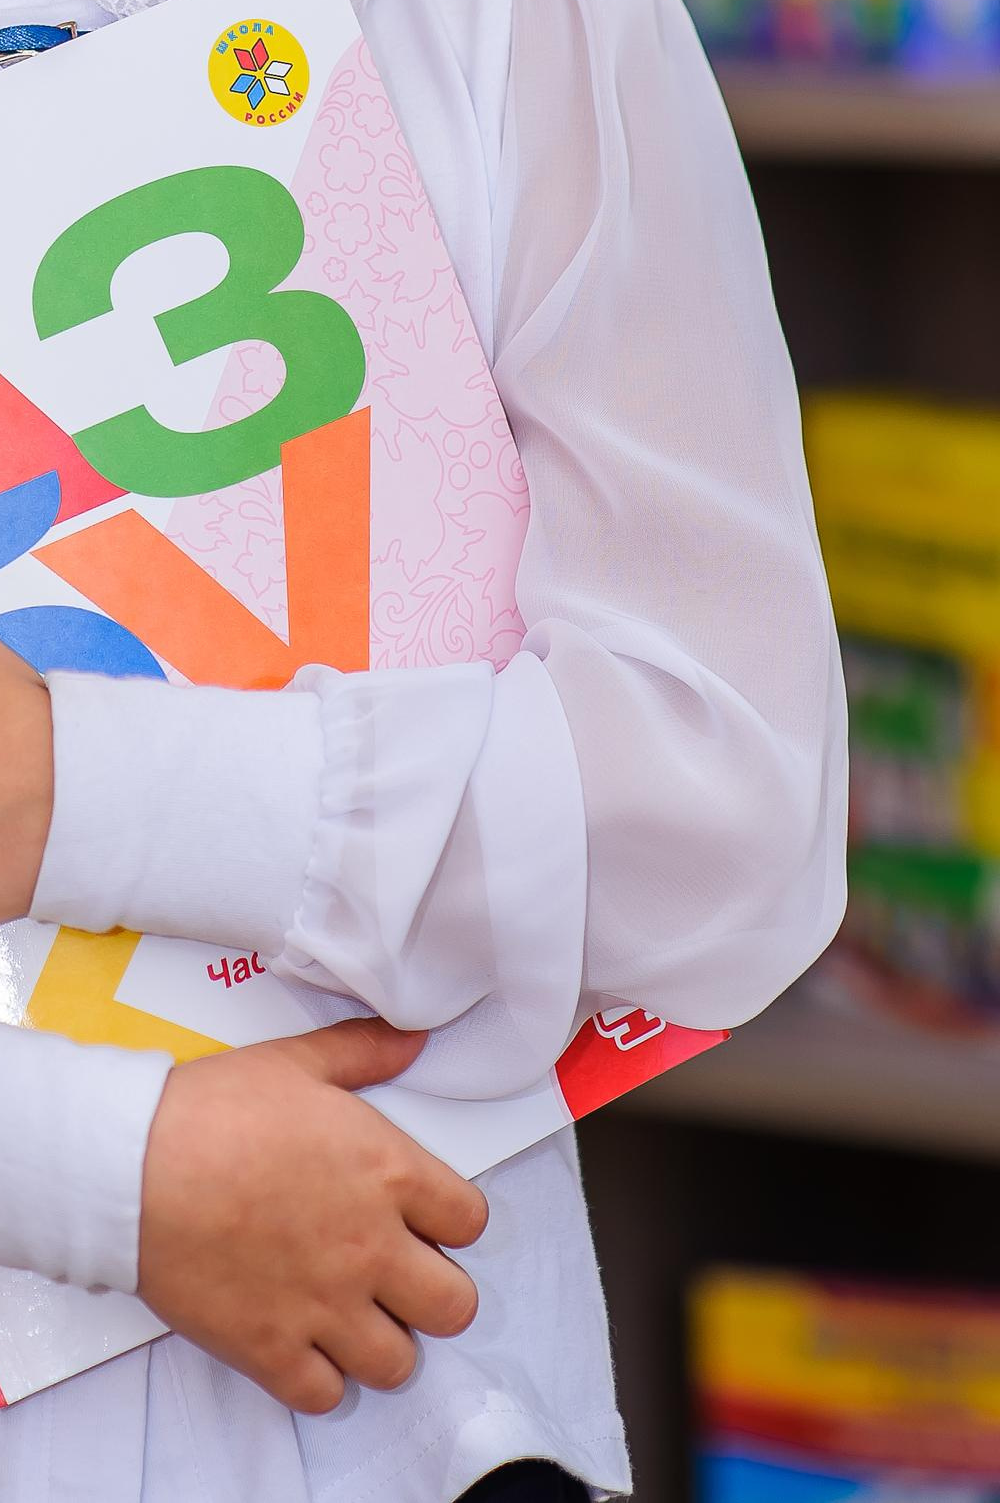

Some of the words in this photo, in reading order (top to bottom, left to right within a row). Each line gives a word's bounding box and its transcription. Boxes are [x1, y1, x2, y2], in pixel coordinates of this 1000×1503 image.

[216, 22, 274, 54] ШКОЛА
[244, 92, 304, 125] РОССИИ
[206, 951, 266, 989] Час
